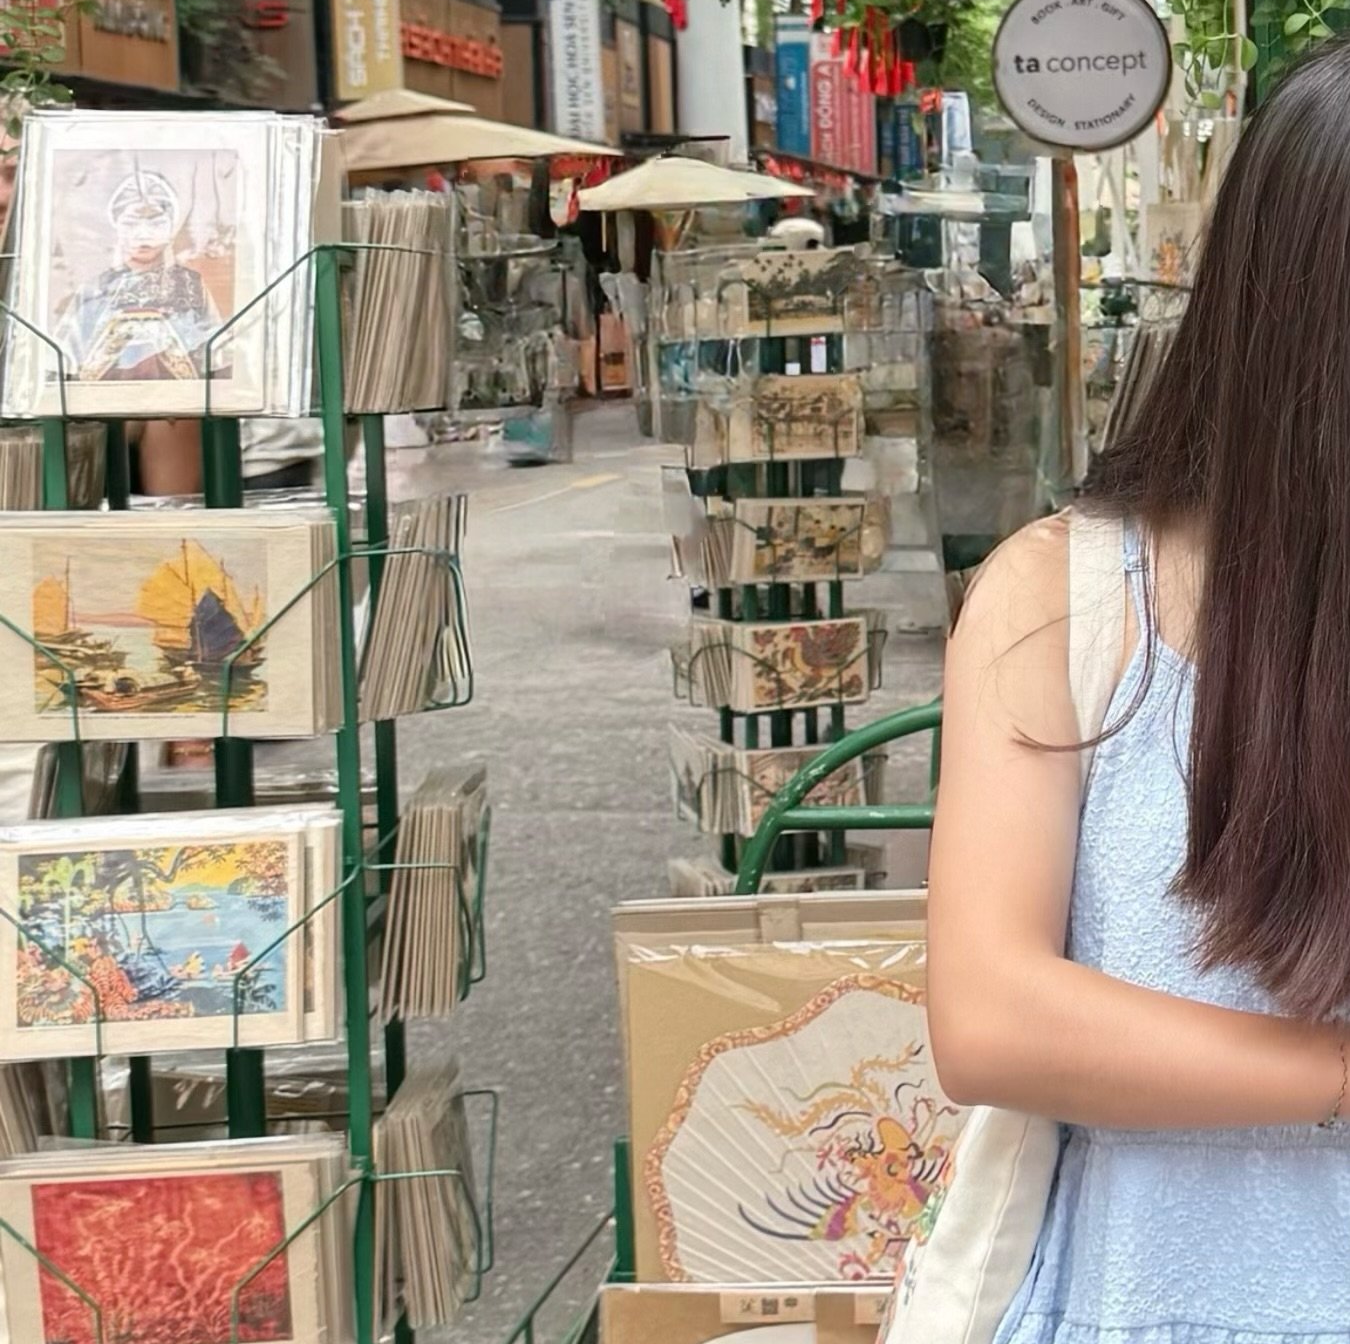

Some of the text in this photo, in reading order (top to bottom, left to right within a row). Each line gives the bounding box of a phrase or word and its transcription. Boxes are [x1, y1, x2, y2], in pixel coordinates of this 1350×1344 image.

[1030, 0, 1063, 25] BOOK
[1101, 1, 1126, 22] GIFT
[1014, 51, 1147, 76] ta concept
[1027, 92, 1136, 131] DESIGN STATIONARY
